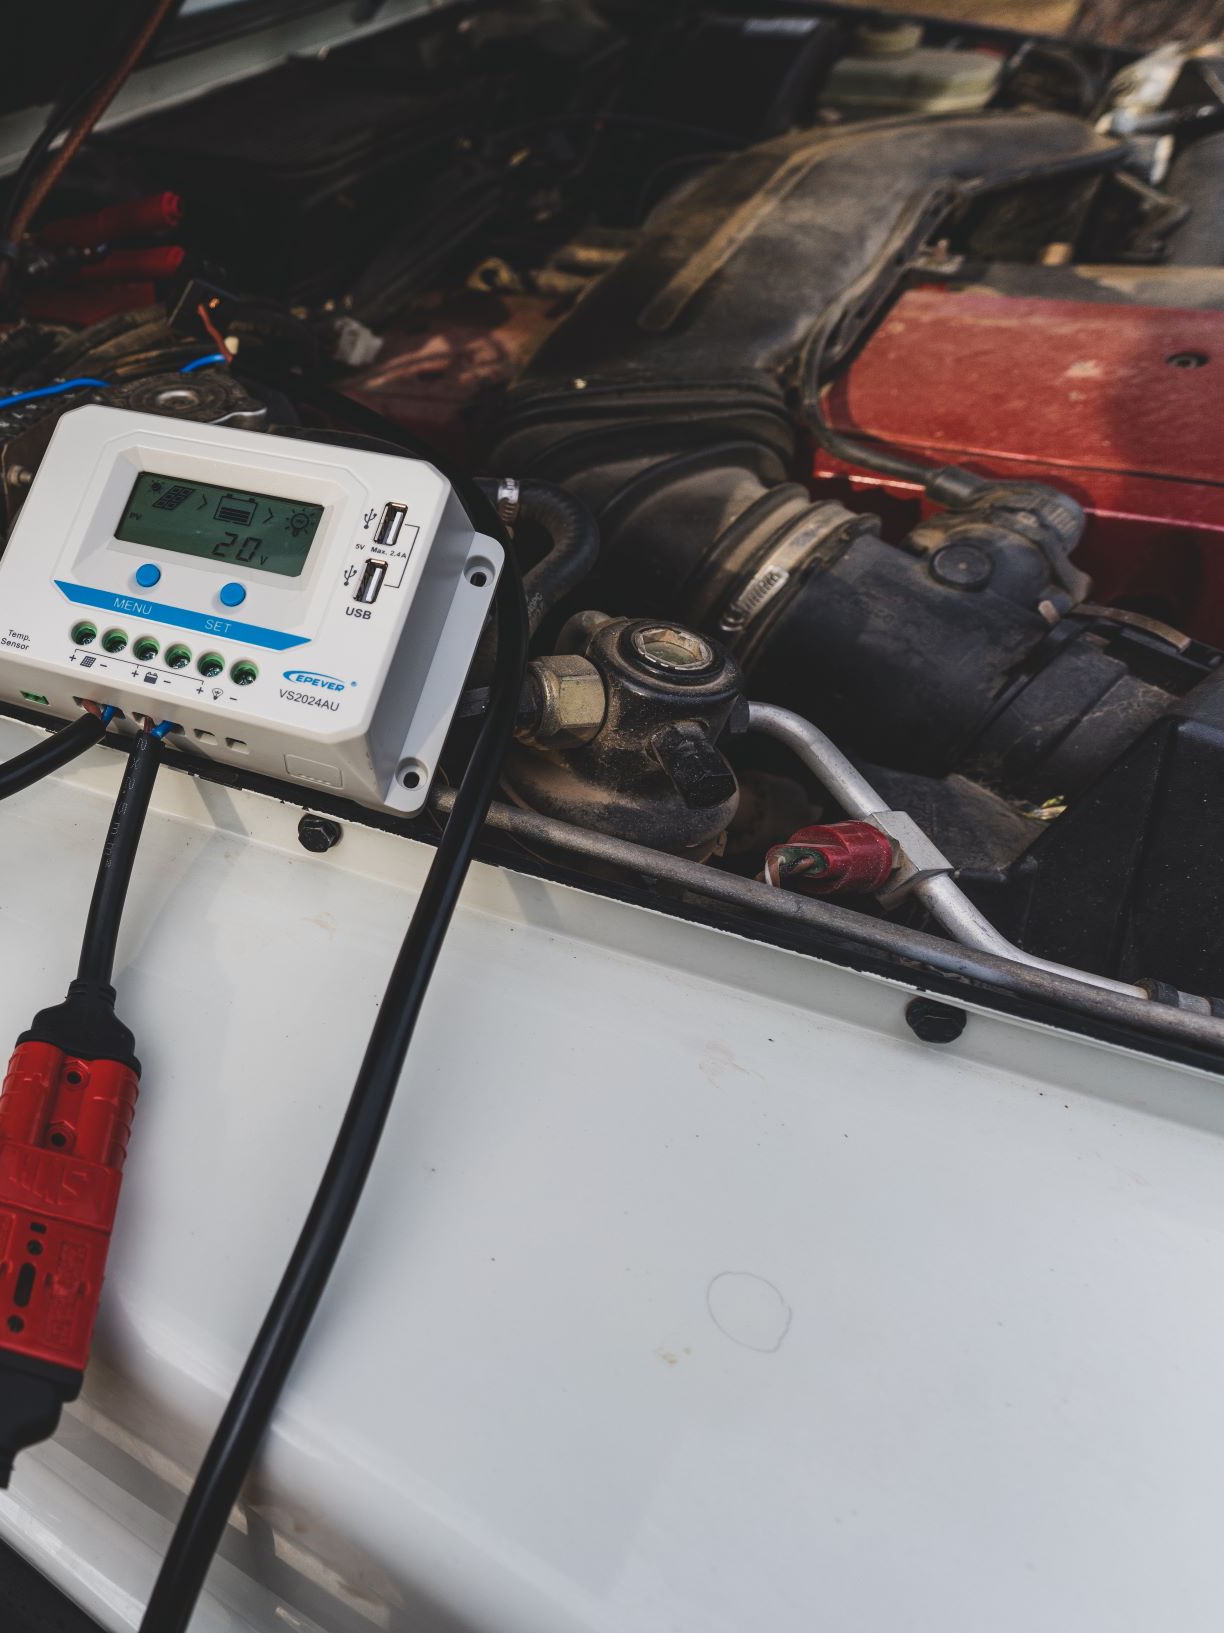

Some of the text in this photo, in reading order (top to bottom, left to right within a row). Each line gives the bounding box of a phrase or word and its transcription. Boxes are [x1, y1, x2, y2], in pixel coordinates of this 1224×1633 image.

[355, 543, 366, 551] 5V
[370, 546, 387, 556] Max.
[113, 597, 153, 616] MENU
[345, 606, 372, 620] USB
[204, 619, 233, 634] SET
[7, 629, 31, 643] Temp.
[0, 637, 30, 651] Sensor
[295, 674, 345, 692] EPEVER
[279, 688, 341, 712] VS2024AU
